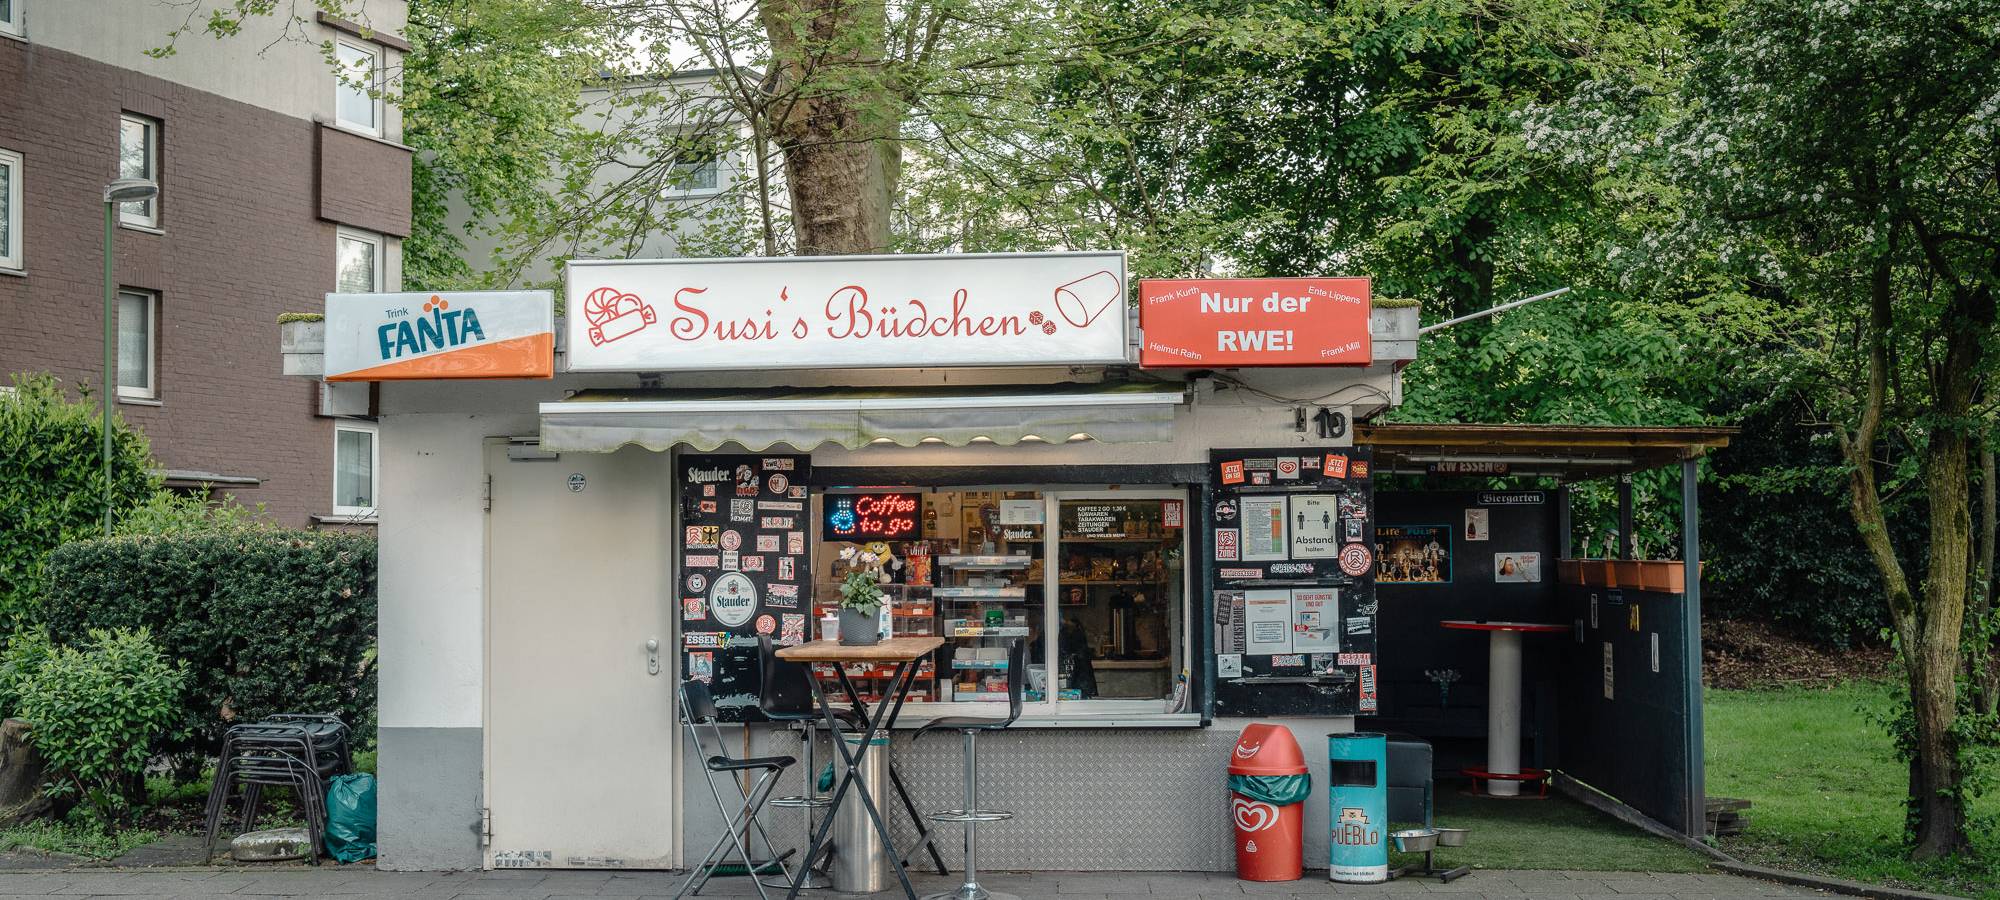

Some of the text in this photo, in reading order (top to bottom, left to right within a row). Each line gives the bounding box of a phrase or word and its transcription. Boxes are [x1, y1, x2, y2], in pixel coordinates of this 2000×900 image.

[1149, 286, 1200, 304] Frank Kurth
[1200, 292, 1312, 313] Nur der
[1308, 286, 1361, 305] Ente Lippens
[385, 307, 409, 319] Trink
[825, 284, 1027, 339] Büdchen
[377, 307, 486, 360] FANTA
[1217, 330, 1294, 352] RWE!
[1149, 341, 1202, 360] Helmut Rahn
[1321, 341, 1361, 358] Frank Mill
[1225, 464, 1240, 473] JETZT
[1328, 459, 1345, 468] JETZT
[1459, 462, 1493, 472] ESSEN
[856, 495, 916, 515] Coffee
[1483, 491, 1541, 504] Biergarten
[860, 517, 914, 535] to go
[1295, 536, 1334, 545] Abstand
[686, 635, 718, 645] ESSEN
[1331, 823, 1379, 846] PUEBLO
